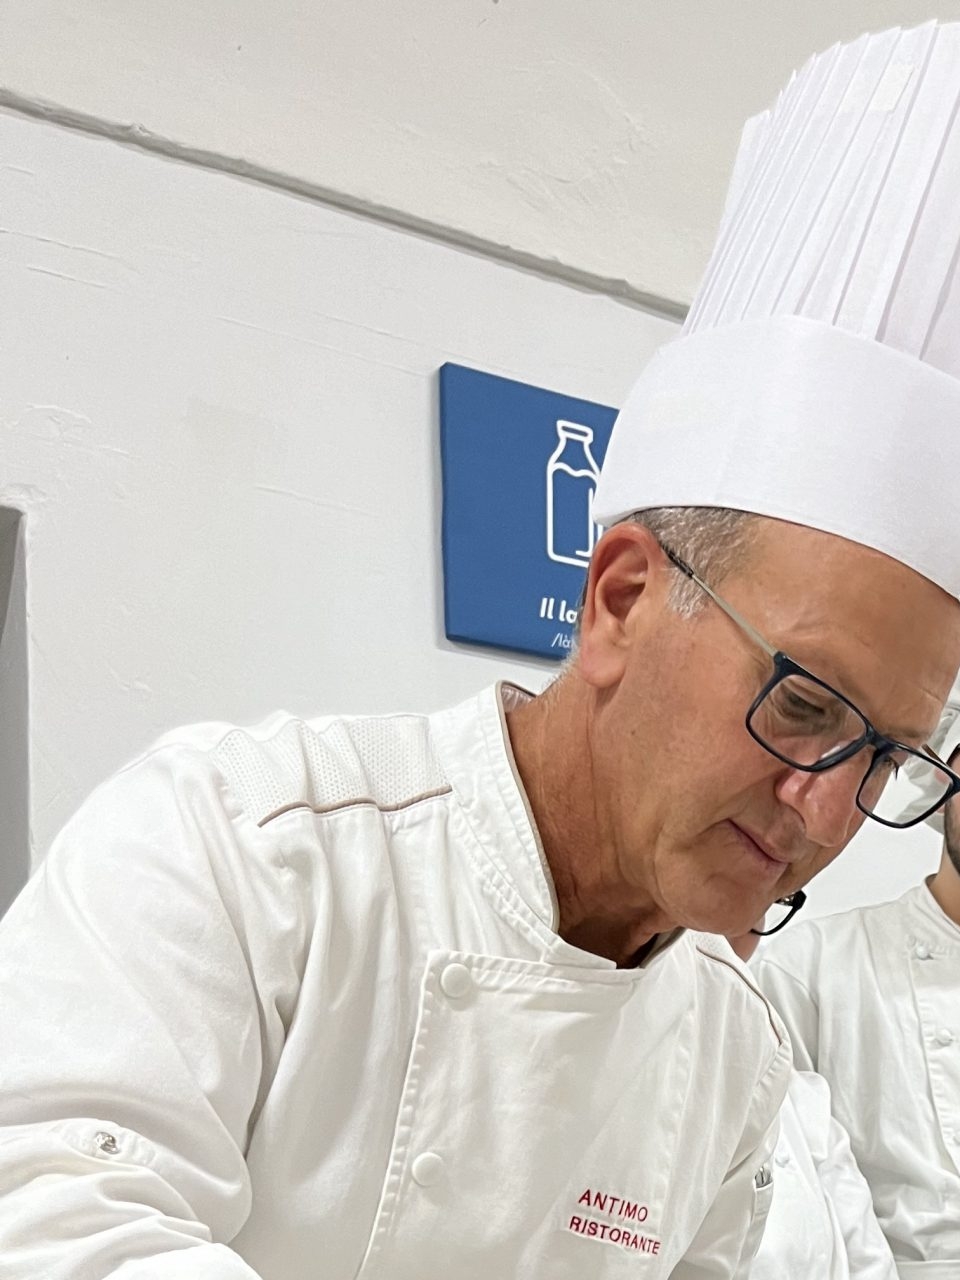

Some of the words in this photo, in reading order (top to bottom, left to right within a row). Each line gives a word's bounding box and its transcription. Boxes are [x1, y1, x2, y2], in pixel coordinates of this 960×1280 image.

[540, 597, 555, 620] Il
[578, 1188, 649, 1223] ANTIMO
[568, 1215, 661, 1255] RISTORANTE
